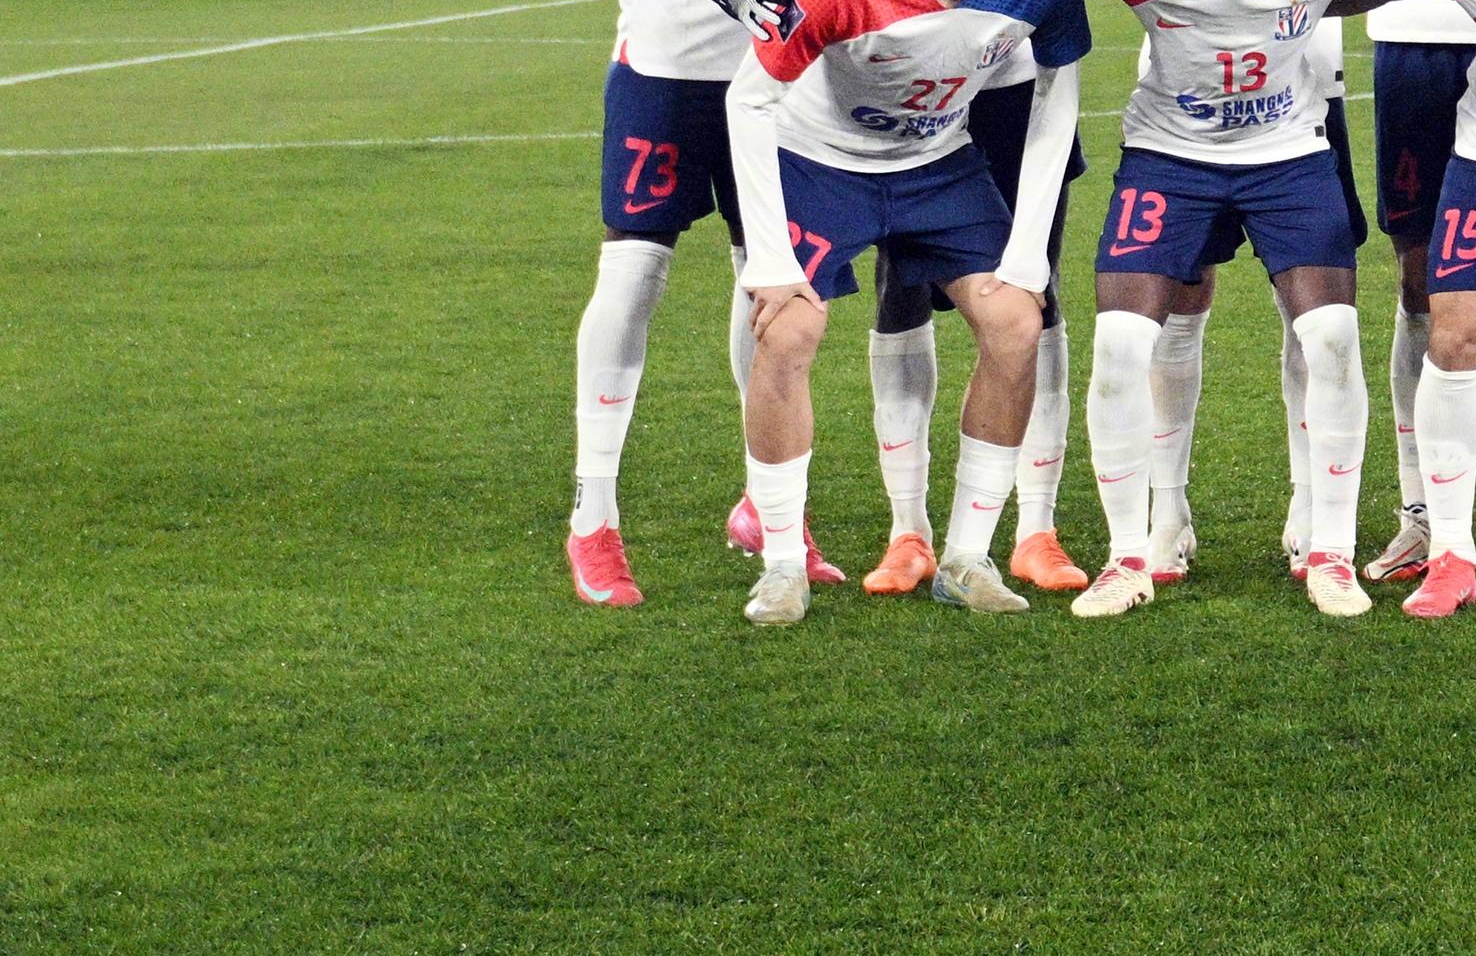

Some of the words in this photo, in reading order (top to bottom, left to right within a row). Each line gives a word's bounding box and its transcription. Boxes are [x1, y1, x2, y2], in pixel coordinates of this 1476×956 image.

[900, 77, 967, 111] 27
[1216, 51, 1268, 94] 13
[624, 137, 681, 197] 73
[1116, 188, 1168, 243] 13
